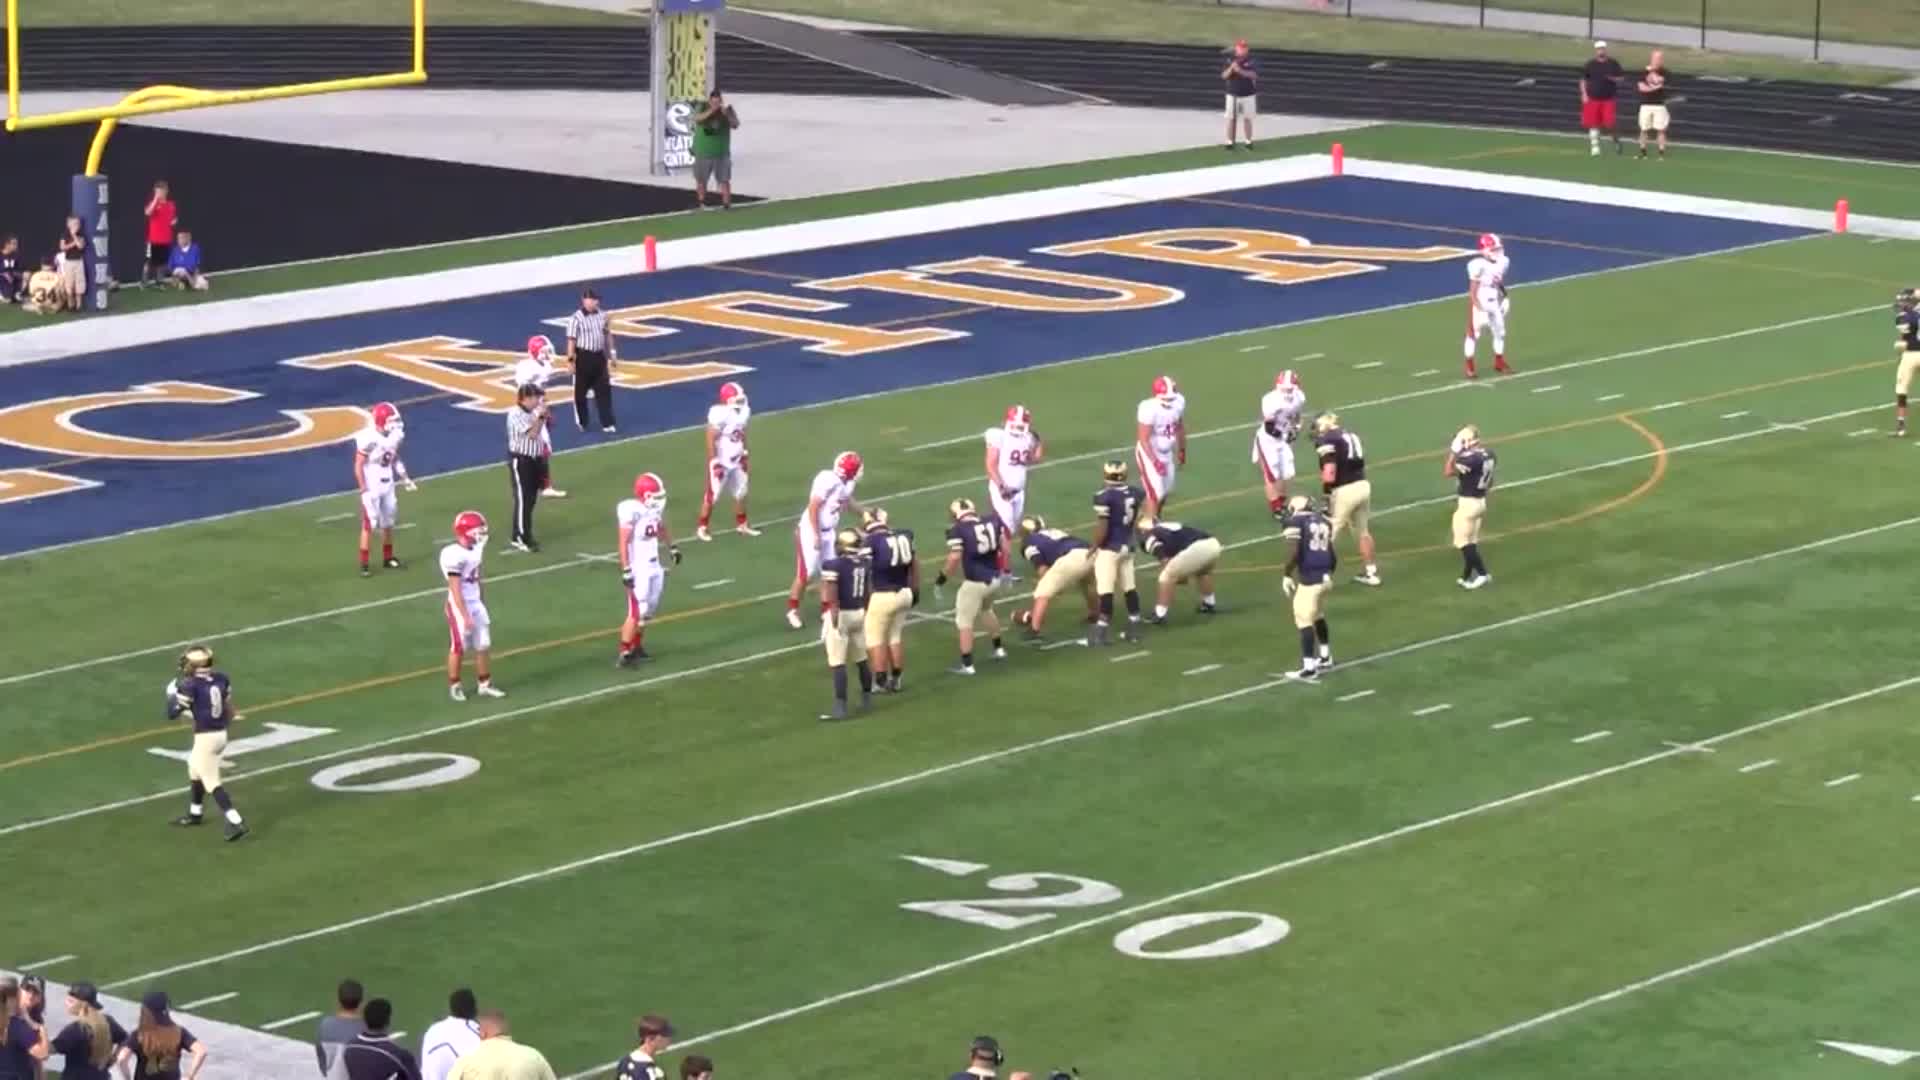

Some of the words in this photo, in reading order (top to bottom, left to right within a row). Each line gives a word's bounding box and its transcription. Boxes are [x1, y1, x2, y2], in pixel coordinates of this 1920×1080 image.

[0, 227, 1478, 507] CATUR
[1122, 496, 1136, 526] 5
[885, 535, 913, 568] 70
[973, 523, 998, 554] 51
[898, 871, 1292, 960] 20
